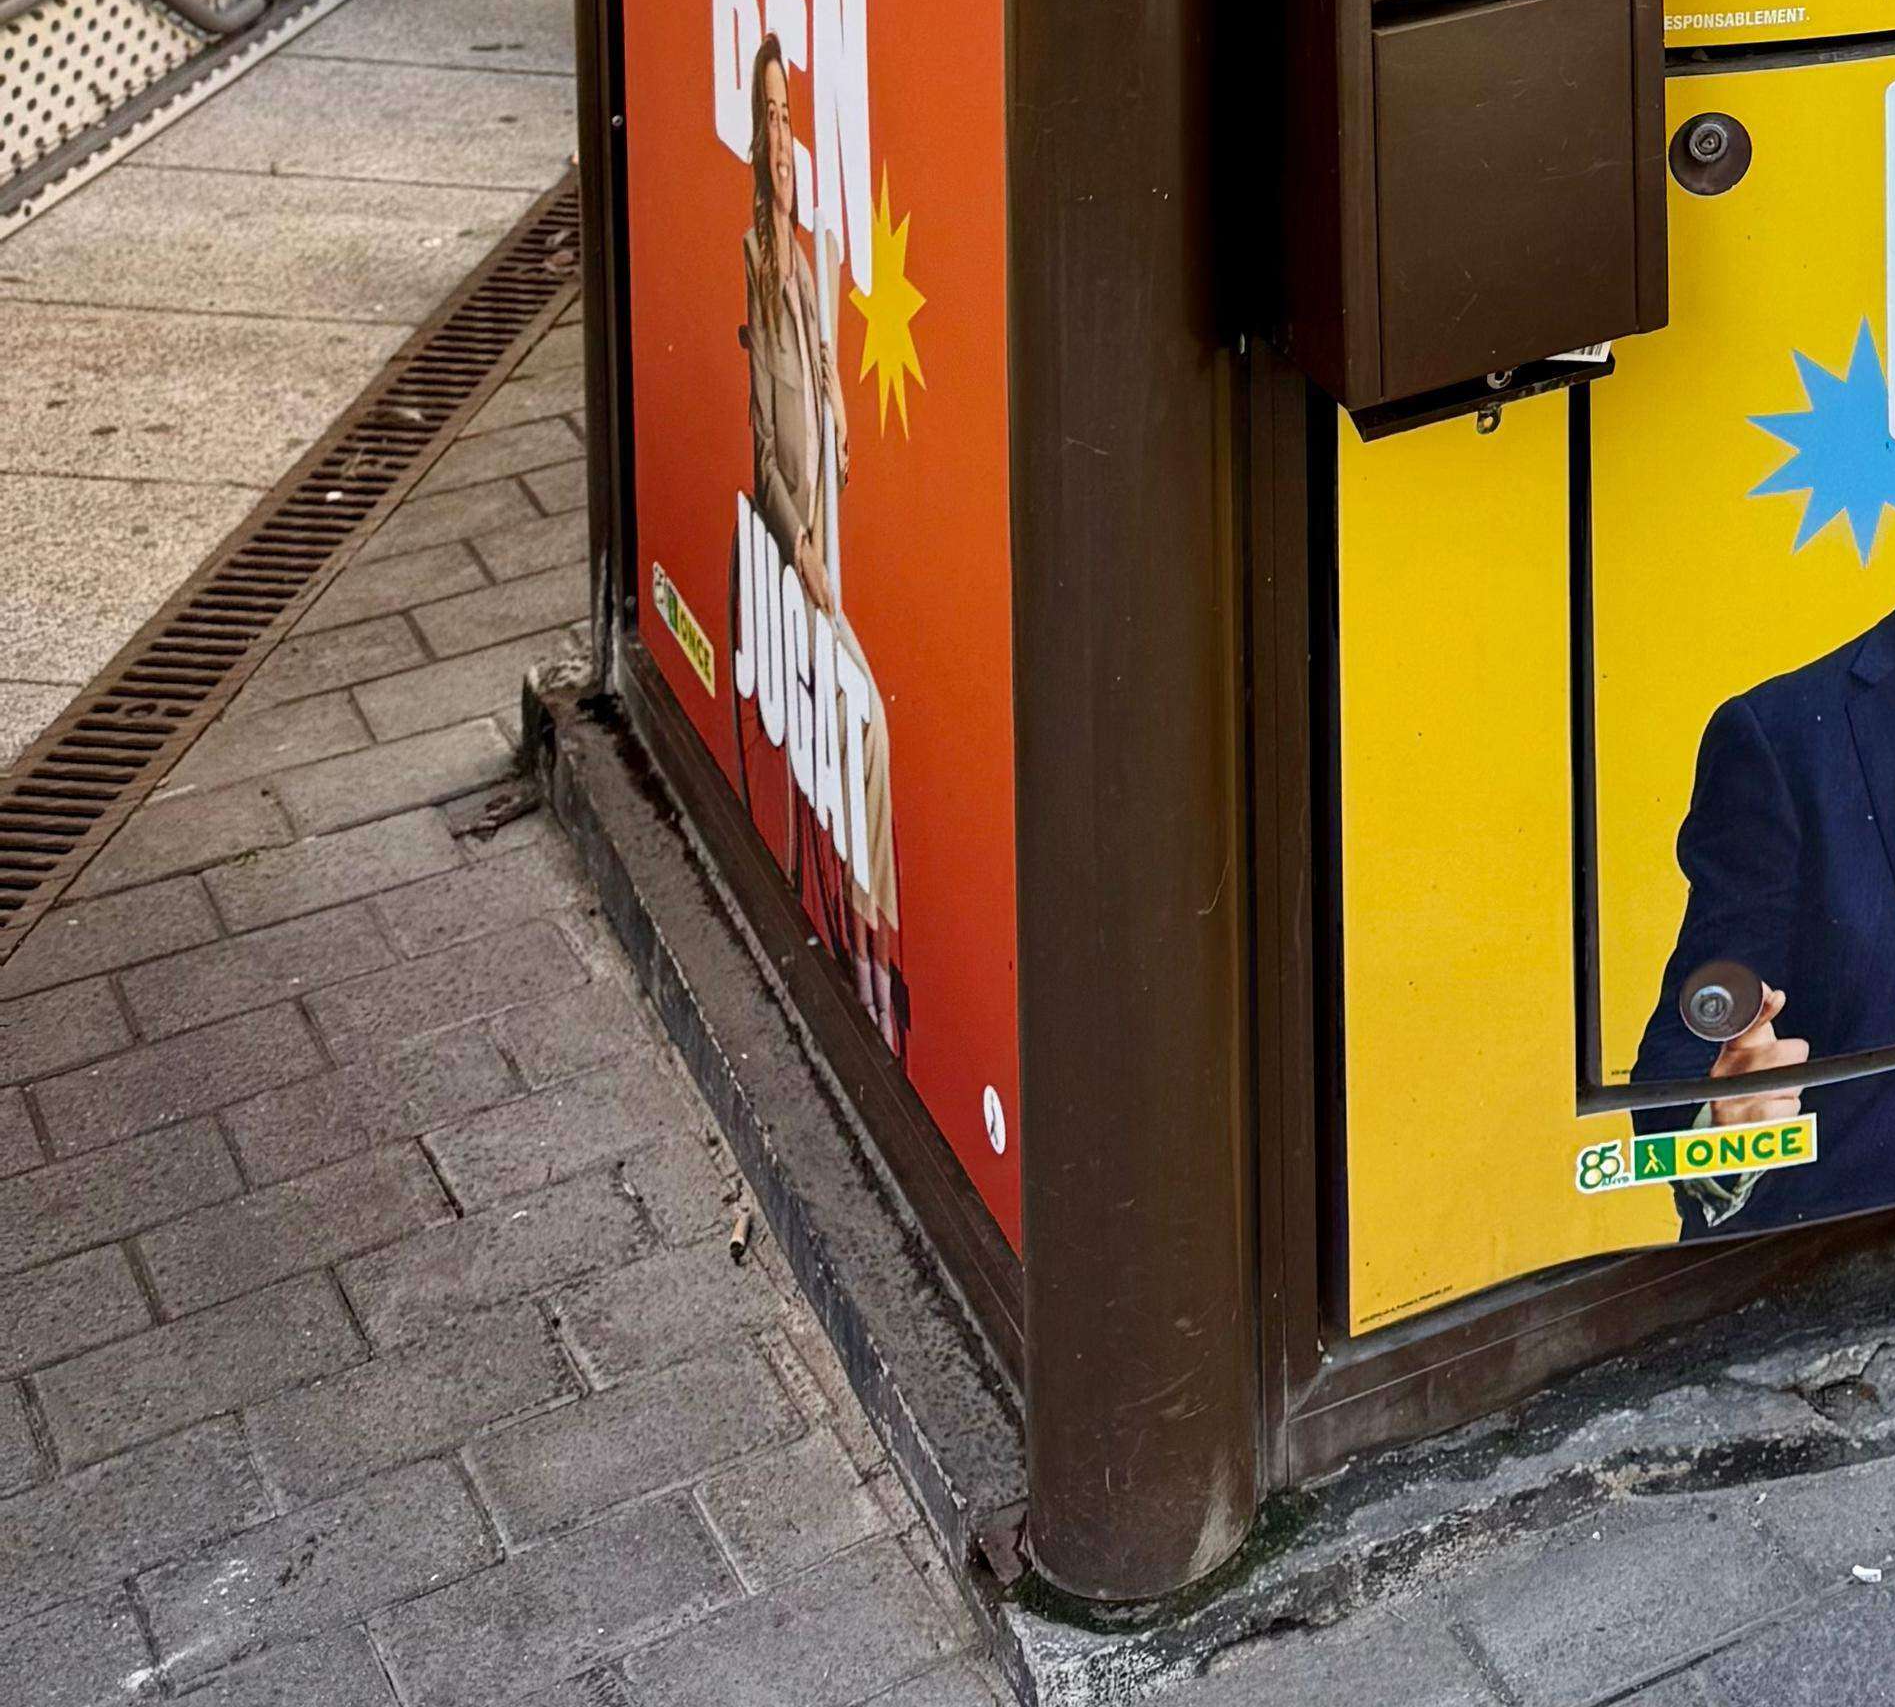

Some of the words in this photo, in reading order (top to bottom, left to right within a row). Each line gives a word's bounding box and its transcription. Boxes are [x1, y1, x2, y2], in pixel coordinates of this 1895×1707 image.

[736, 490, 870, 894] JUGAT
[1580, 1143, 1620, 1189] 85
[1686, 1126, 1803, 1167] ONCE
